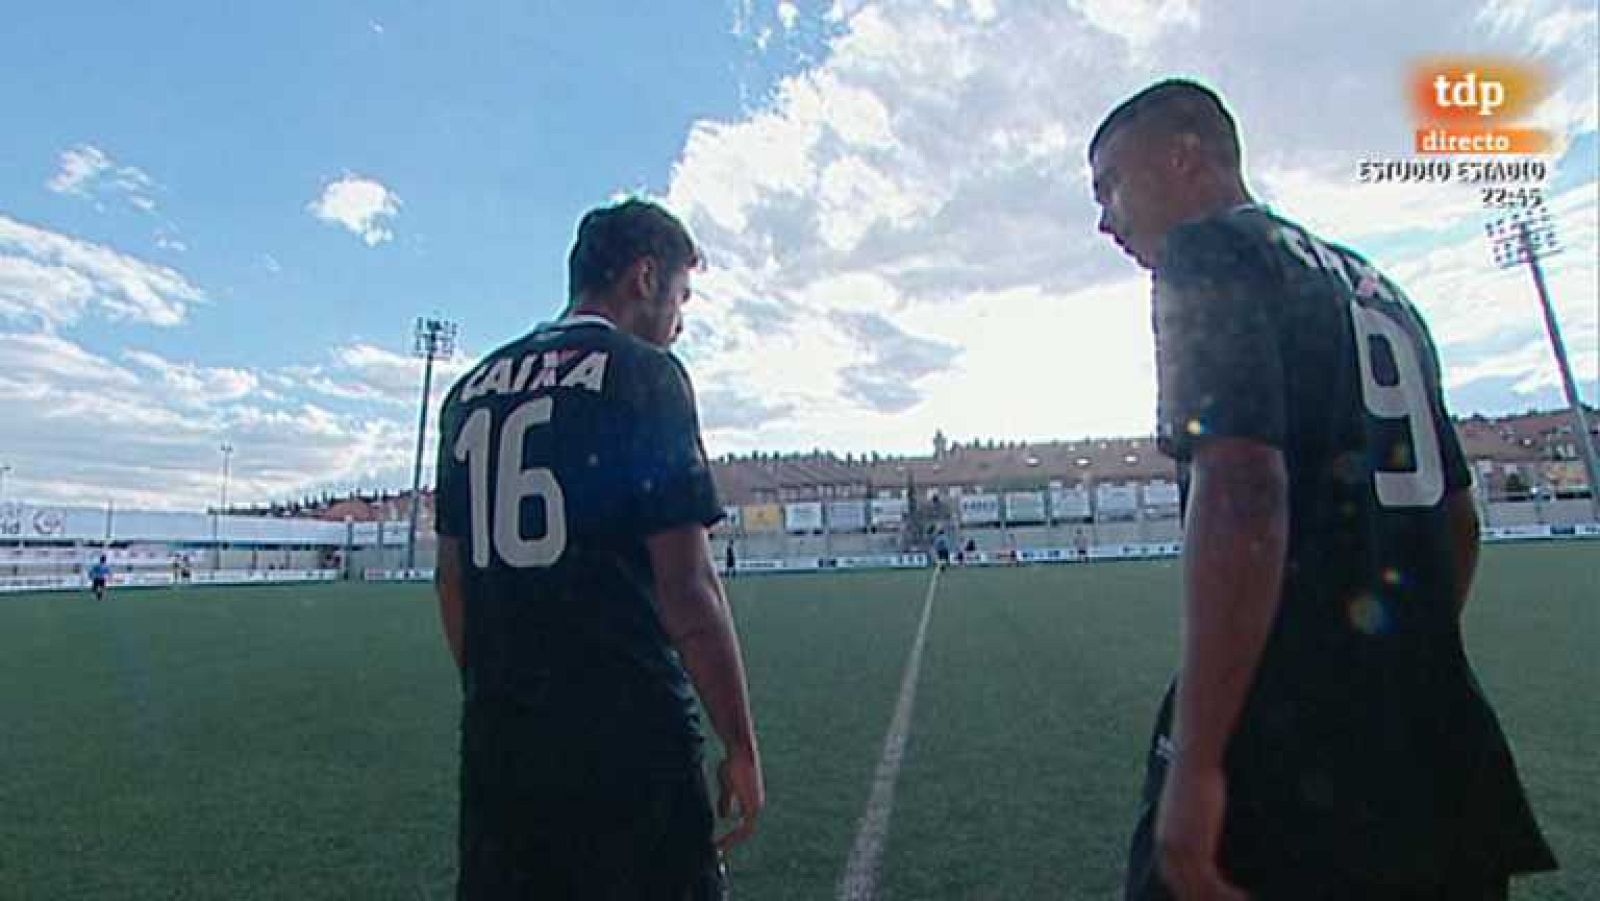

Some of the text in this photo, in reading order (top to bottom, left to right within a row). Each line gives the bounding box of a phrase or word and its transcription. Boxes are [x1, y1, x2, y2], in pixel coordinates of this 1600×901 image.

[459, 350, 609, 402] CAIXA
[1351, 299, 1446, 507] 9
[454, 395, 568, 568] 16
